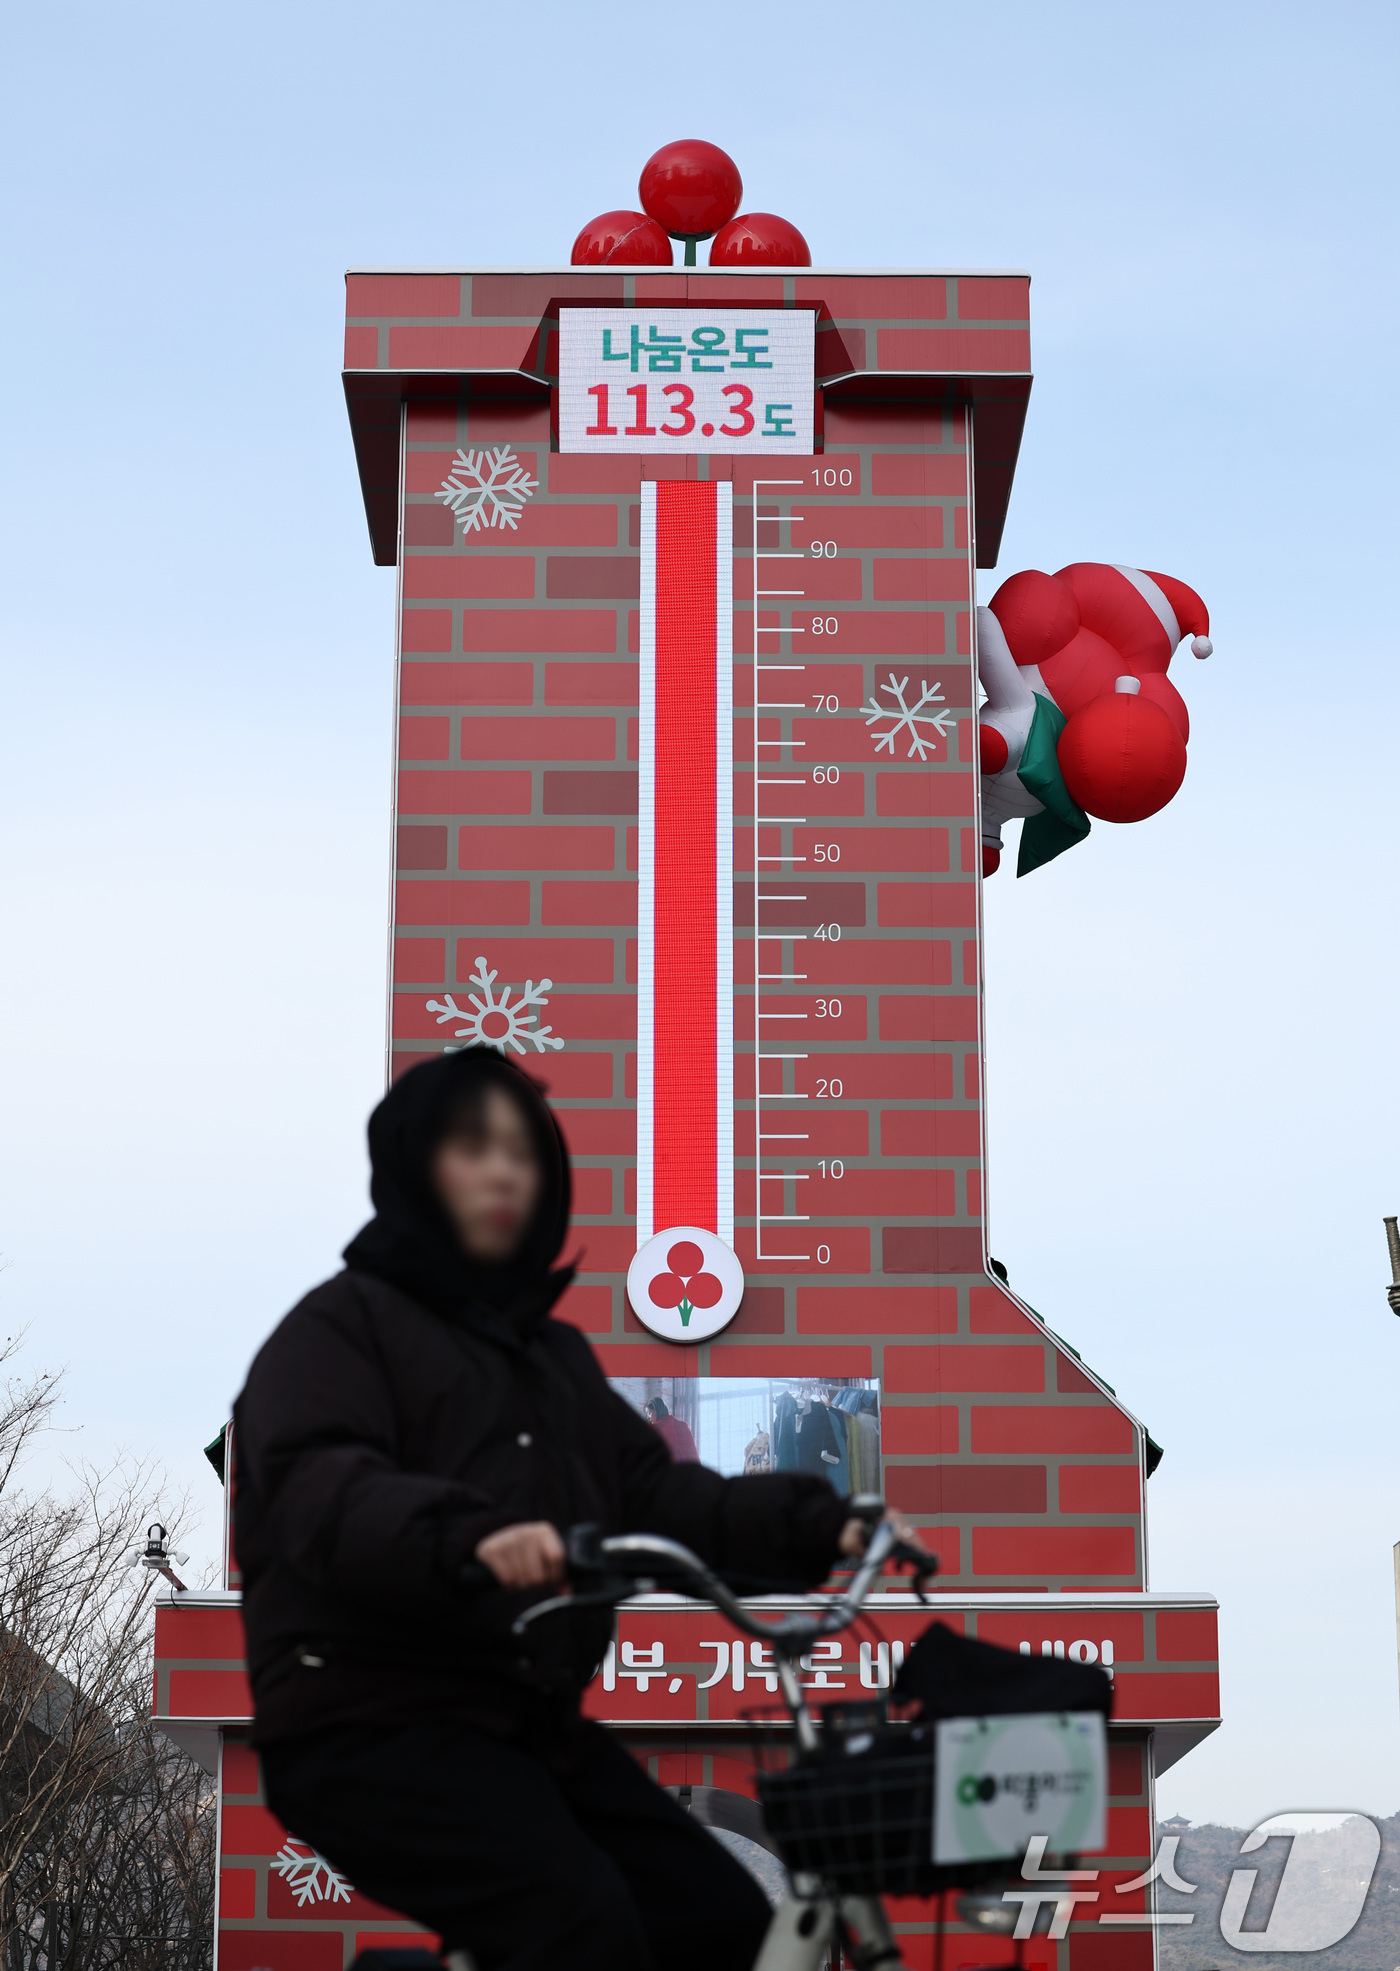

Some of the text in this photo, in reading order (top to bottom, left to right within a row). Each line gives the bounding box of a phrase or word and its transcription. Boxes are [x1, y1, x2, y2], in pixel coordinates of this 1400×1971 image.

[602, 325, 773, 372] 나눔온도
[586, 383, 796, 437] 113.3도
[810, 468, 853, 487] 100
[810, 540, 838, 559] 90
[811, 616, 839, 635] 80
[811, 694, 840, 714] 70
[812, 765, 840, 785] 60
[813, 843, 841, 863] 50
[813, 923, 842, 942] 40
[814, 998, 843, 1019] 30
[815, 1078, 844, 1099] 20
[816, 1159, 844, 1180] 10
[816, 1244, 831, 1265] 0
[697, 1640, 846, 1692] 기부로
